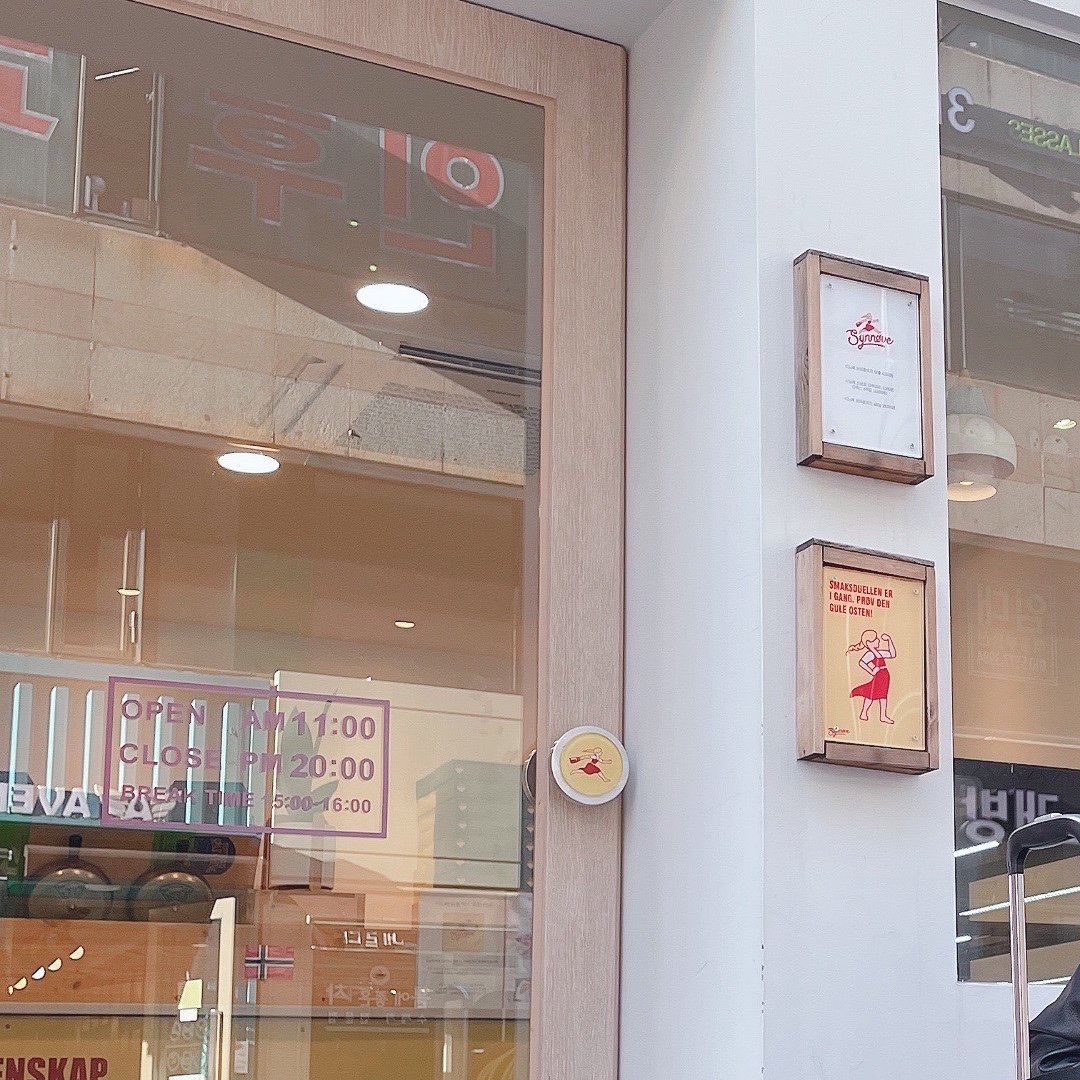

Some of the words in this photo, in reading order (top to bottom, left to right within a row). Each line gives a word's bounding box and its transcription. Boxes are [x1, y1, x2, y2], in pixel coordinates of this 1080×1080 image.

[829, 580, 883, 597] SMAKSDUELLEN
[885, 589, 893, 598] ER
[829, 603, 846, 614] GULE
[849, 606, 873, 617] OSTEN!
[877, 599, 890, 608] DEN
[121, 699, 205, 726] OPEN
[241, 709, 285, 732] AM
[291, 711, 376, 740] 11:00
[119, 743, 221, 769] CLOSE
[241, 751, 283, 775] PM
[290, 753, 375, 781] 20:00
[120, 784, 197, 805] BREAK
[204, 789, 255, 808] TIME
